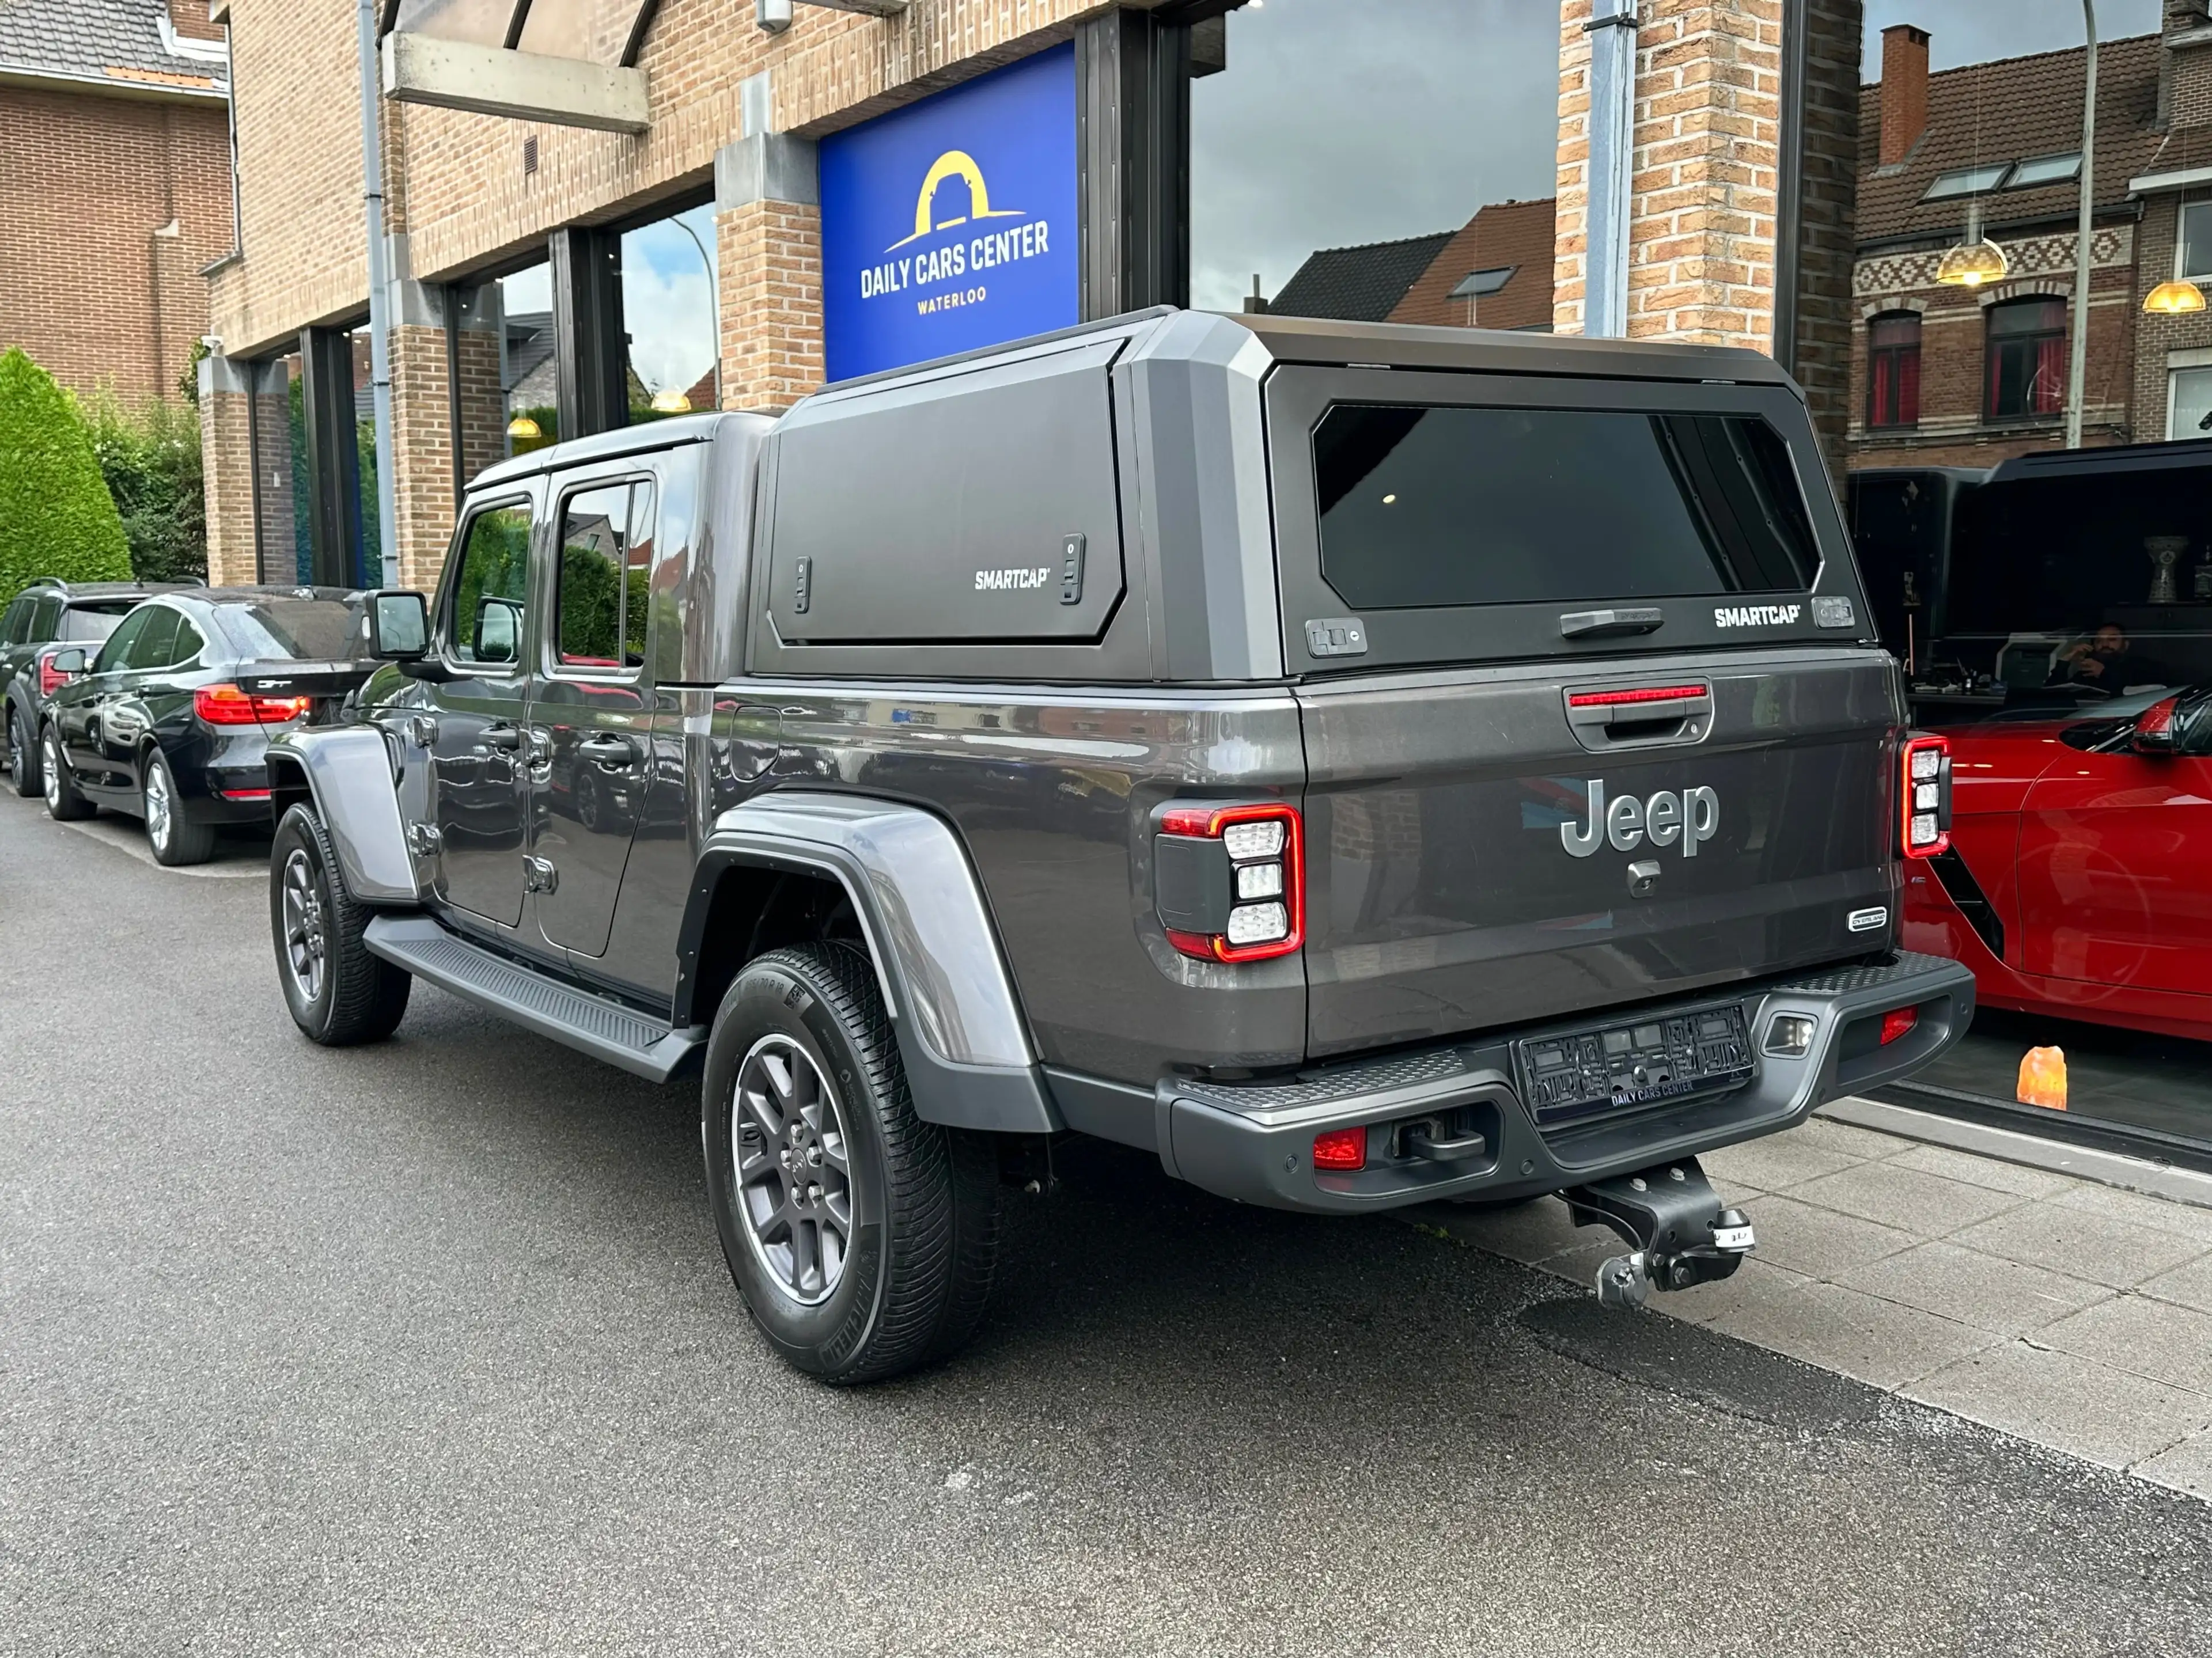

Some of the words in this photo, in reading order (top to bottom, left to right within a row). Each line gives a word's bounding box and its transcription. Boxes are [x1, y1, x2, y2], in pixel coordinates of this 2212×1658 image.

[861, 257, 910, 298] DAILY
[915, 244, 965, 285] CARS
[971, 221, 1049, 271] CENTER
[918, 286, 986, 315] WATERLOO
[975, 568, 1047, 590] SMARTCAP
[1714, 605, 1798, 627] SMARTCAP
[1560, 779, 1719, 858] Jeep
[1611, 1091, 1636, 1107] DAILY
[1638, 1086, 1661, 1101] CARS
[1662, 1079, 1694, 1095] CENTER
